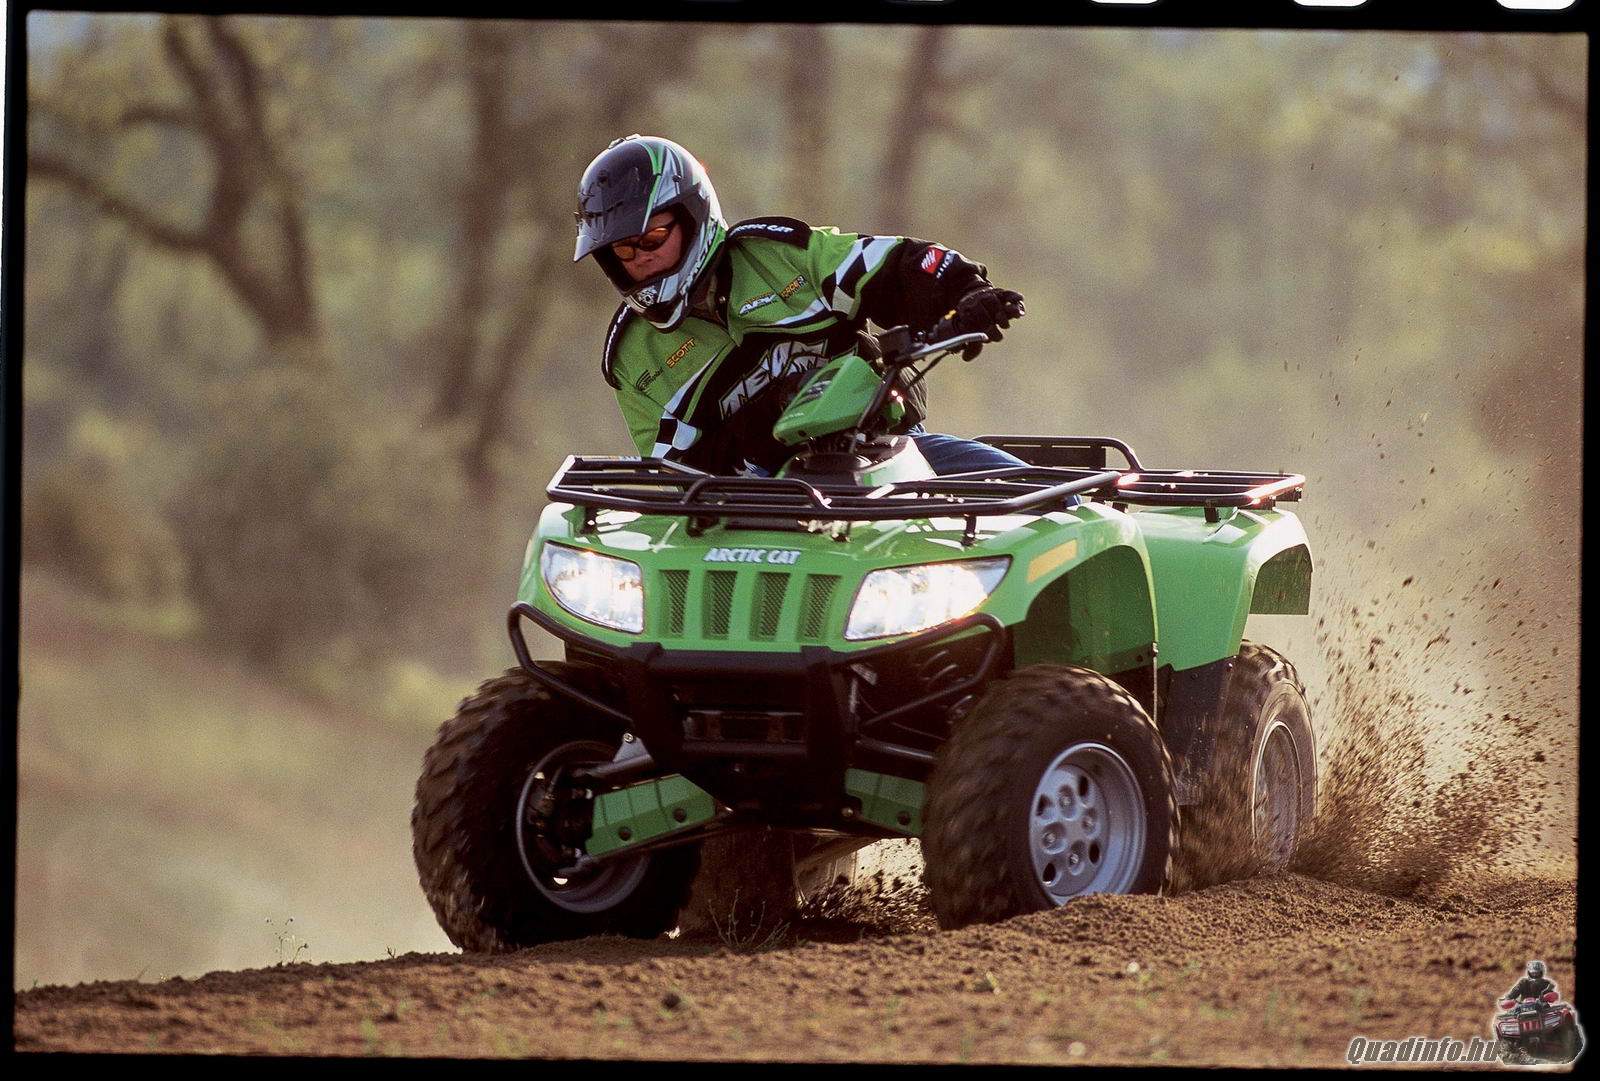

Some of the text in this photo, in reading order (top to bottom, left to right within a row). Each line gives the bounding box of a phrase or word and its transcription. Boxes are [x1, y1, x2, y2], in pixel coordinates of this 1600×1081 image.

[665, 337, 696, 369] SCOTT
[703, 547, 801, 565] ARCTIC CAT
